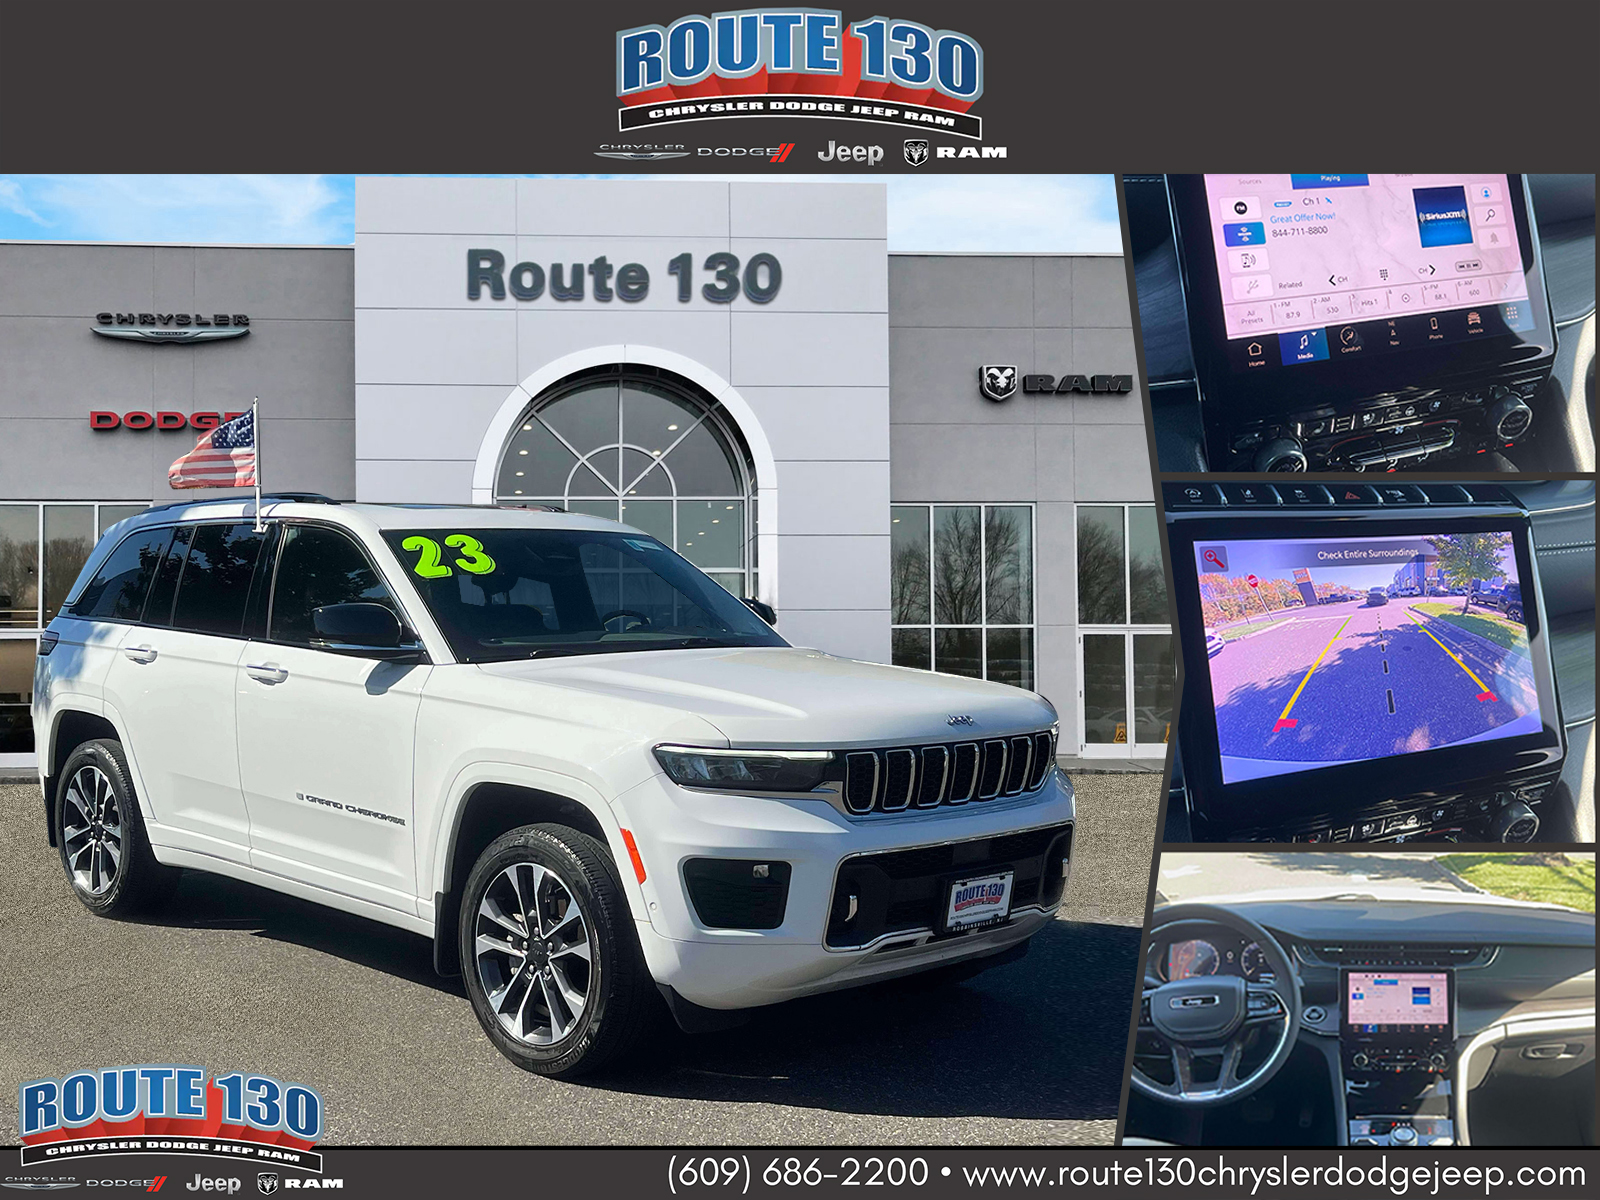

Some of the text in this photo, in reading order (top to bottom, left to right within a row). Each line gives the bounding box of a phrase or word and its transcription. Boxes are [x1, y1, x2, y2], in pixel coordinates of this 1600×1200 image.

[1302, 197, 1314, 206] Ch
[1269, 212, 1336, 224] Great Offer Now!
[1271, 226, 1329, 238] 844-711-8800
[467, 248, 783, 304] Route 130
[1278, 281, 1303, 290] Related
[96, 312, 250, 326] CHRYSLER
[1241, 317, 1264, 325] Presets
[1286, 311, 1301, 319] 87.9
[1340, 345, 1362, 354] Comfort
[1297, 352, 1314, 361] Media
[1248, 360, 1266, 368] Home
[1023, 374, 1133, 394] RAM
[402, 534, 497, 579] 23
[1317, 547, 1420, 561] Check Entire Surroundings
[955, 884, 987, 906] ROUTE
[987, 882, 1006, 897] 130
